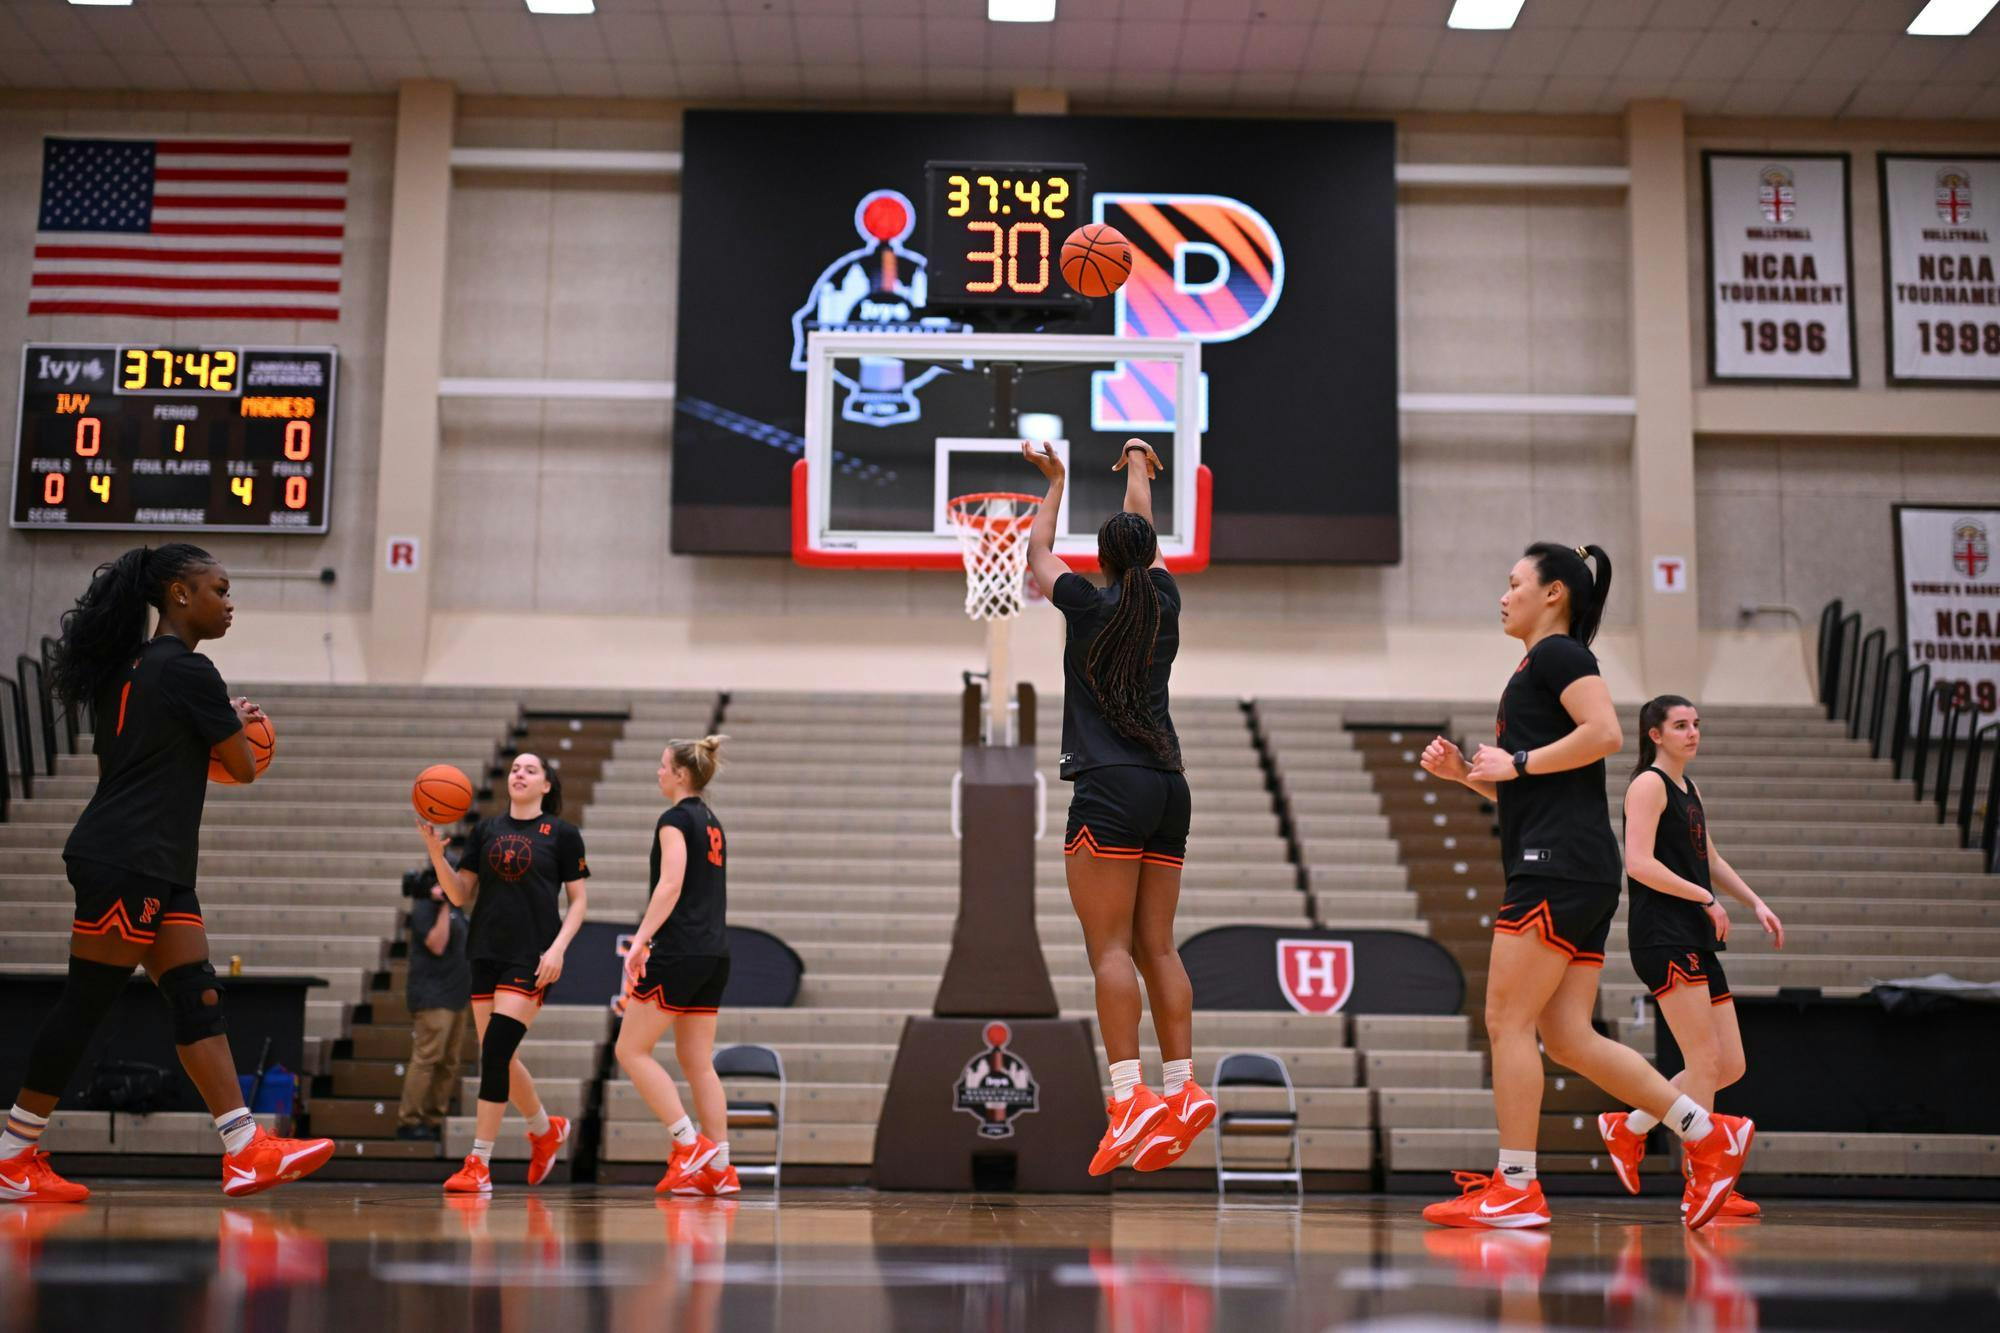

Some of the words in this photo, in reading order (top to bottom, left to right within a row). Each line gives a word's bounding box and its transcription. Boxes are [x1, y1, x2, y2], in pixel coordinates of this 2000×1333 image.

[948, 175, 1069, 219] 37:42
[967, 221, 1050, 292] 30
[1743, 254, 1817, 281] NCAA
[1919, 255, 1994, 282] NCAA
[1720, 284, 1843, 304] TOURNAMENT
[1742, 320, 1826, 354] 1996
[38, 355, 81, 385] Ivy
[124, 350, 236, 391] 37:42
[56, 393, 90, 414] IVY
[153, 405, 199, 420] PERIOD
[75, 417, 101, 457] 0
[175, 424, 185, 453] 1
[284, 420, 311, 461] 0
[31, 458, 71, 473] FOULS
[133, 460, 162, 474] FOUL
[165, 460, 211, 475] PLAYER
[44, 472, 65, 505] 0
[90, 475, 111, 503] 4
[231, 477, 253, 506] 4
[285, 475, 307, 510] 0
[135, 507, 205, 523] ADVANTAGE
[391, 542, 414, 566] R
[1658, 562, 1681, 586] T
[140, 897, 160, 924] P
[1295, 950, 1337, 998] H
